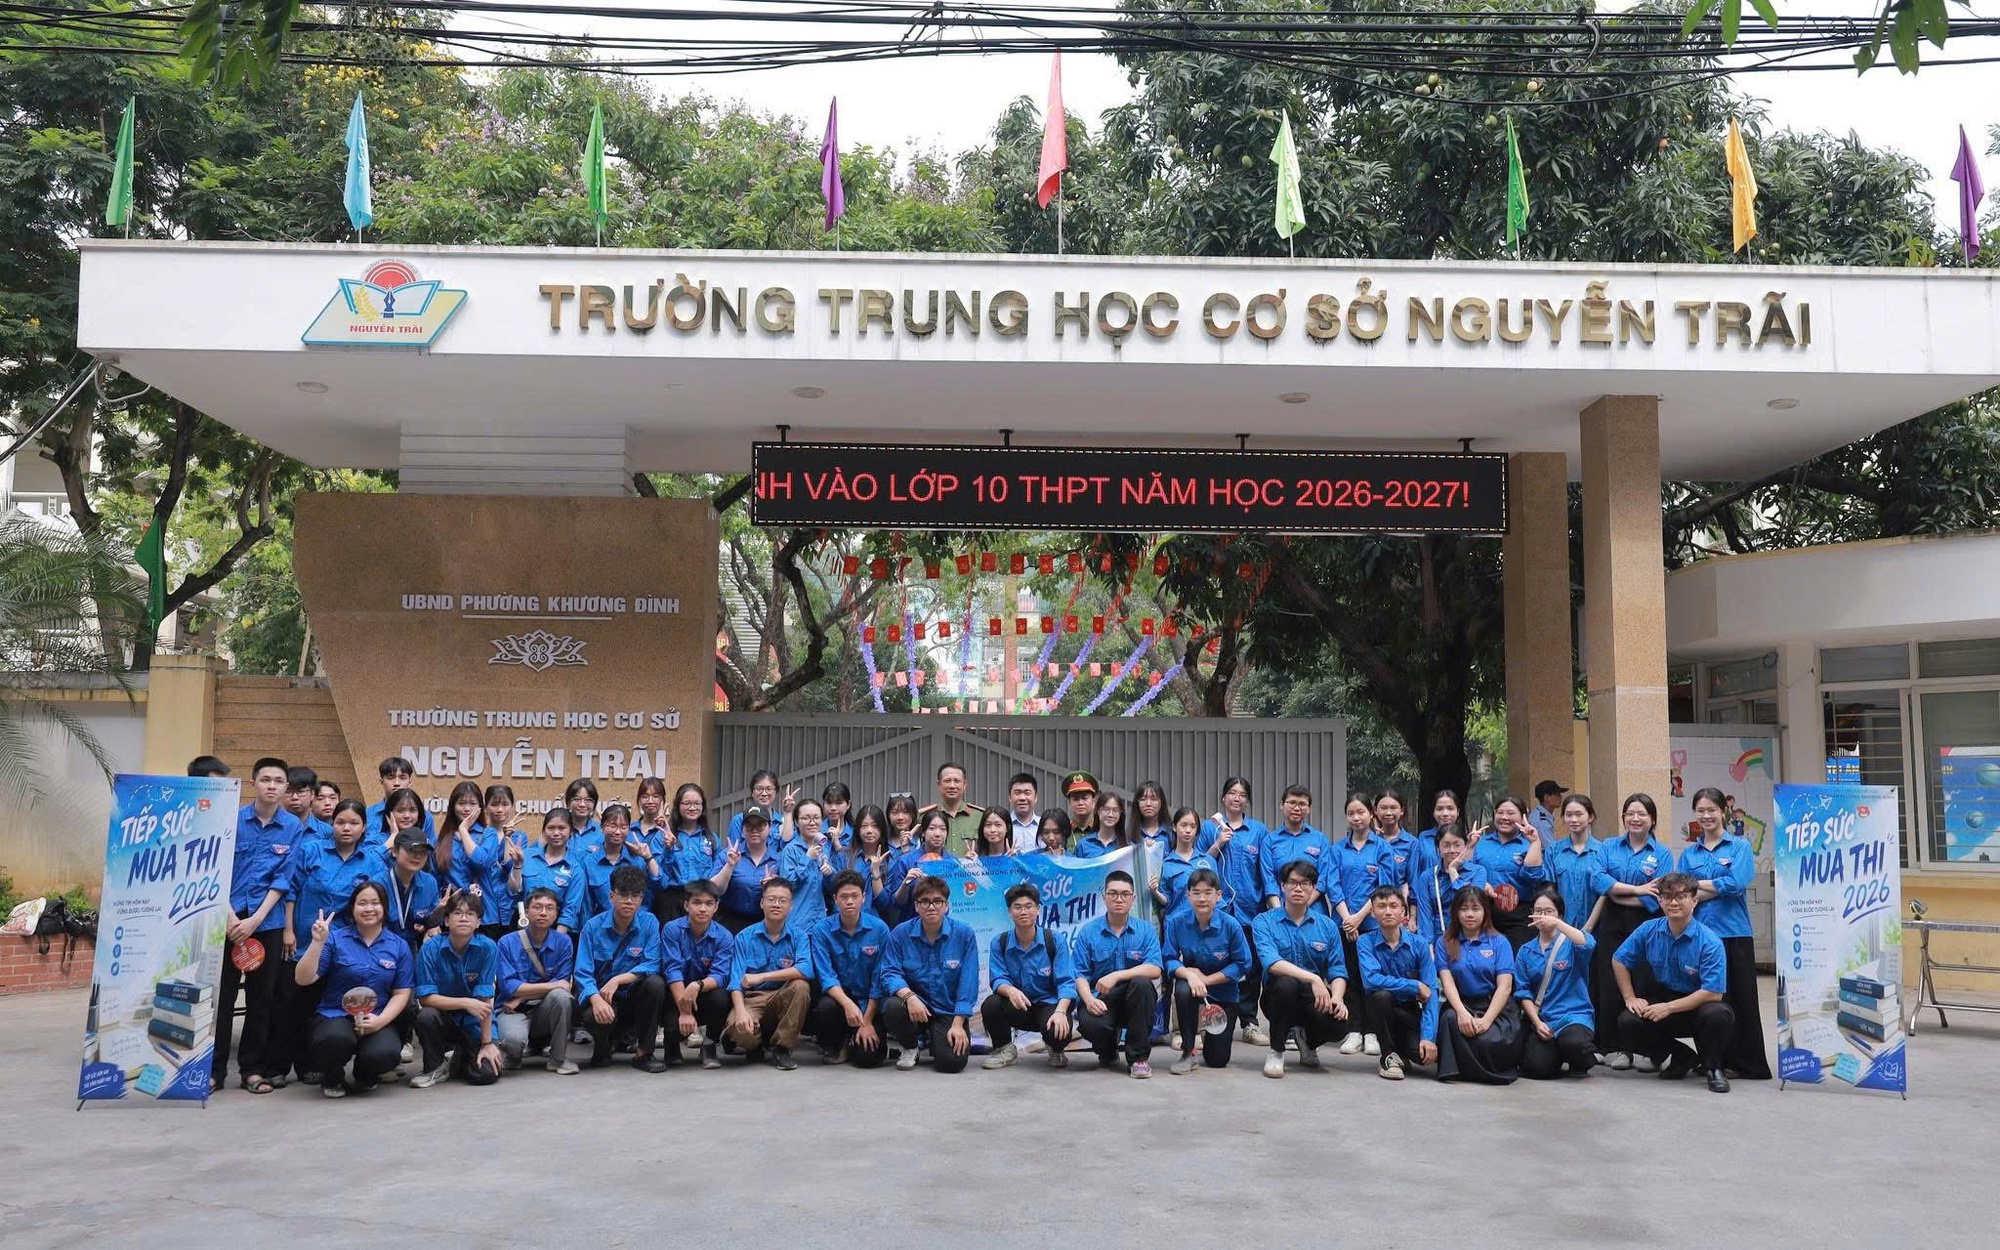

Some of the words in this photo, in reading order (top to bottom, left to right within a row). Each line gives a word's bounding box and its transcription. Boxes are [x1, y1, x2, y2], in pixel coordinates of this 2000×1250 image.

[540, 274, 795, 334] TRƯỜNG
[819, 288, 1028, 338] TRUNG
[1054, 291, 1180, 348] HỌC
[1202, 288, 1287, 340] CƠ
[1306, 276, 1388, 343] SỞ
[1408, 280, 1656, 345] NGUYỄN
[1675, 292, 1812, 347] TRÃI
[803, 466, 878, 501] VÀO
[890, 468, 959, 502] LỚP
[972, 475, 1008, 502] 10
[1018, 475, 1110, 504] THPT
[1121, 470, 1197, 505] NĂM
[1209, 478, 1285, 513] HỌC
[1295, 479, 1470, 508] 2026-2027!
[402, 594, 454, 609] UBND
[461, 592, 539, 611] PHƯỜNG
[548, 595, 626, 612] KHƯƠNG
[635, 593, 680, 614] ĐÌNH
[388, 705, 478, 727] TRƯỜNG
[484, 711, 557, 728] TRUNG
[563, 712, 608, 732] HỌC
[614, 711, 645, 729] CƠ
[650, 706, 681, 730] SỞ
[400, 737, 565, 778] NGUYỄN
[575, 744, 669, 780] TRÃI
[120, 804, 158, 848] TIẾP
[160, 801, 195, 841] SỨC
[1785, 812, 1820, 851] TIẾP
[1824, 808, 1856, 845] SỨC
[127, 838, 177, 889] MÙA
[184, 834, 222, 877] THI
[1799, 843, 1845, 890] MÙA
[1849, 839, 1886, 880] THI
[168, 869, 220, 920] 2026
[1042, 873, 1073, 901] SỨC
[1842, 873, 1890, 919] 2026
[1036, 900, 1061, 929] ÙA
[1065, 892, 1098, 925] THI
